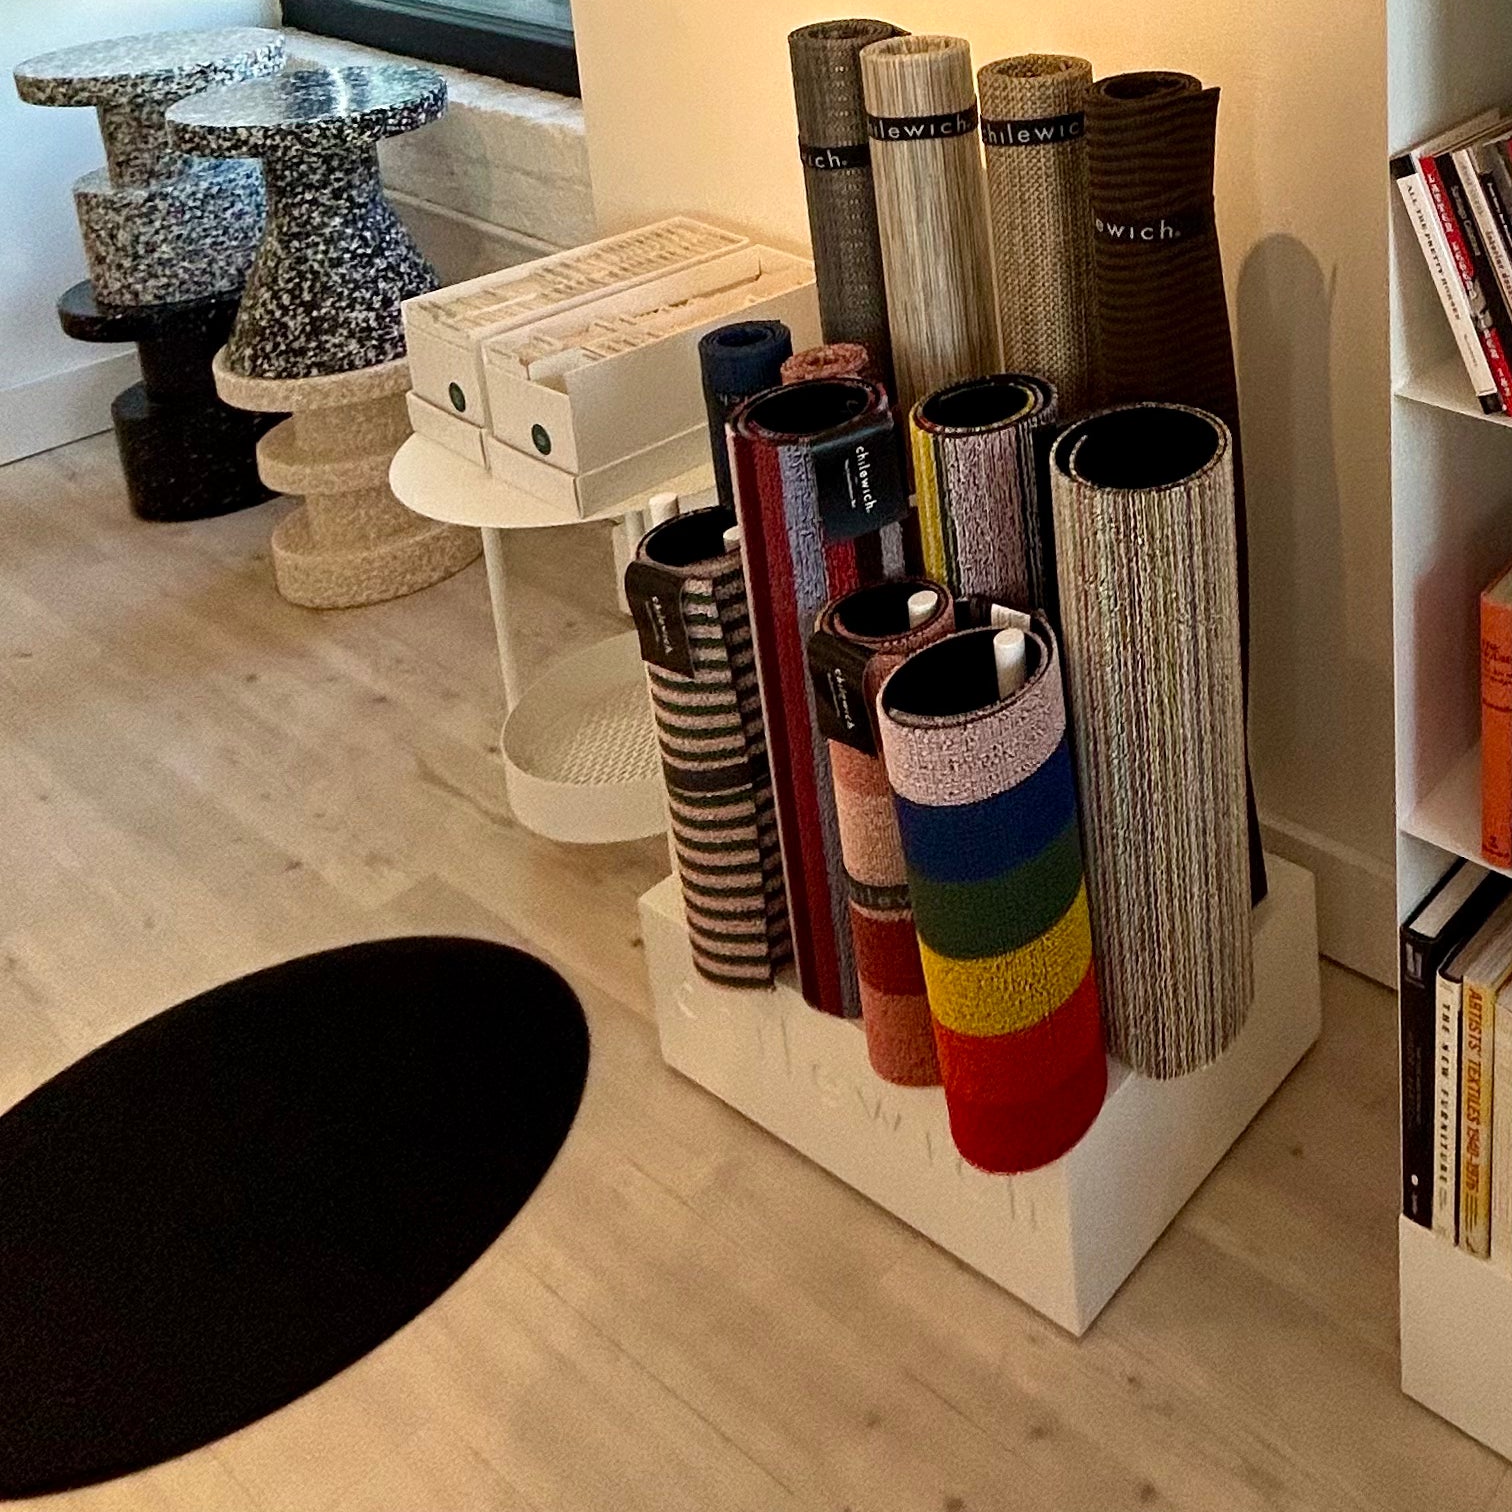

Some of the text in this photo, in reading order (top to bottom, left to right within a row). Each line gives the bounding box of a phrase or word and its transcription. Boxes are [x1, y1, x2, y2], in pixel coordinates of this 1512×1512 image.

[1442, 1003, 1451, 1034] THE
[1467, 1059, 1482, 1125] TEXTILES
[1440, 1089, 1450, 1184] FURNITURE
